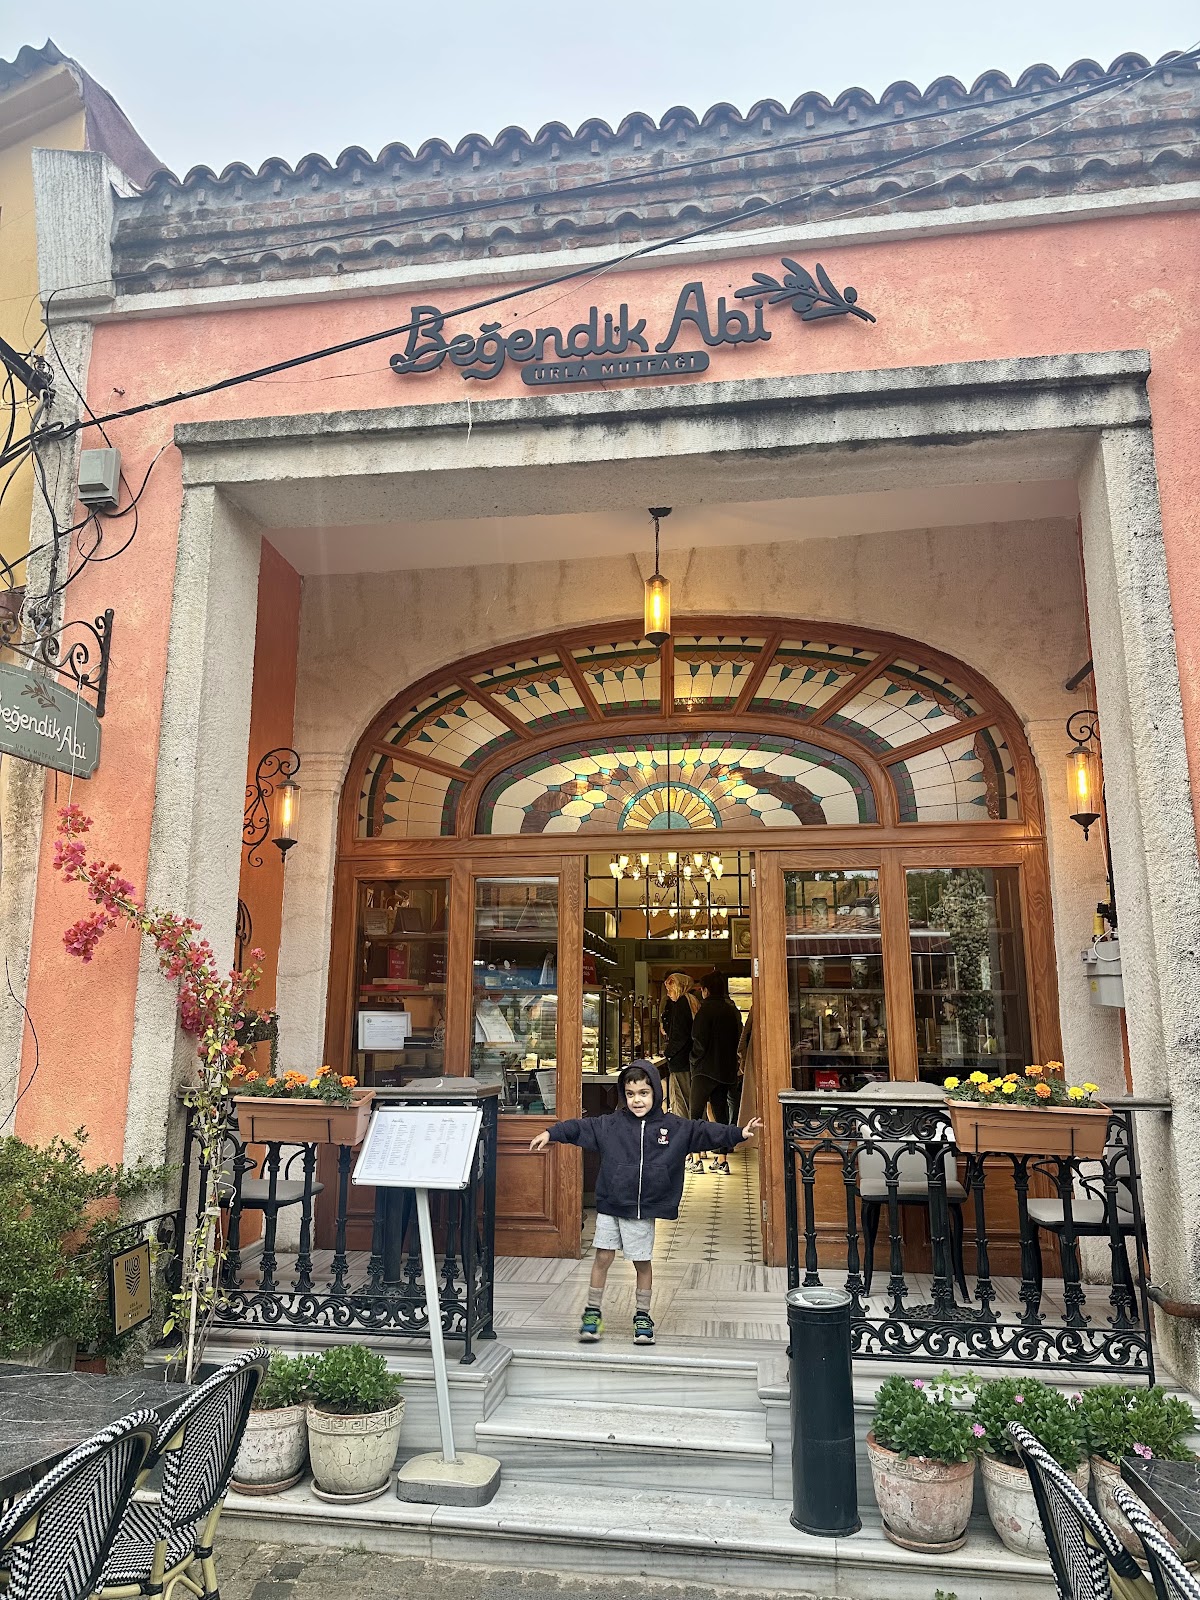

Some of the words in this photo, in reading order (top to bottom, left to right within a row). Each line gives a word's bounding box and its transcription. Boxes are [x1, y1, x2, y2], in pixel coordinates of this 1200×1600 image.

[389, 303, 649, 382] Beğendik
[656, 280, 772, 354] Abi
[534, 364, 589, 381] URLA
[601, 354, 696, 377] MUTFAĞI
[0, 691, 61, 742] eğendik
[56, 725, 87, 760] Abi
